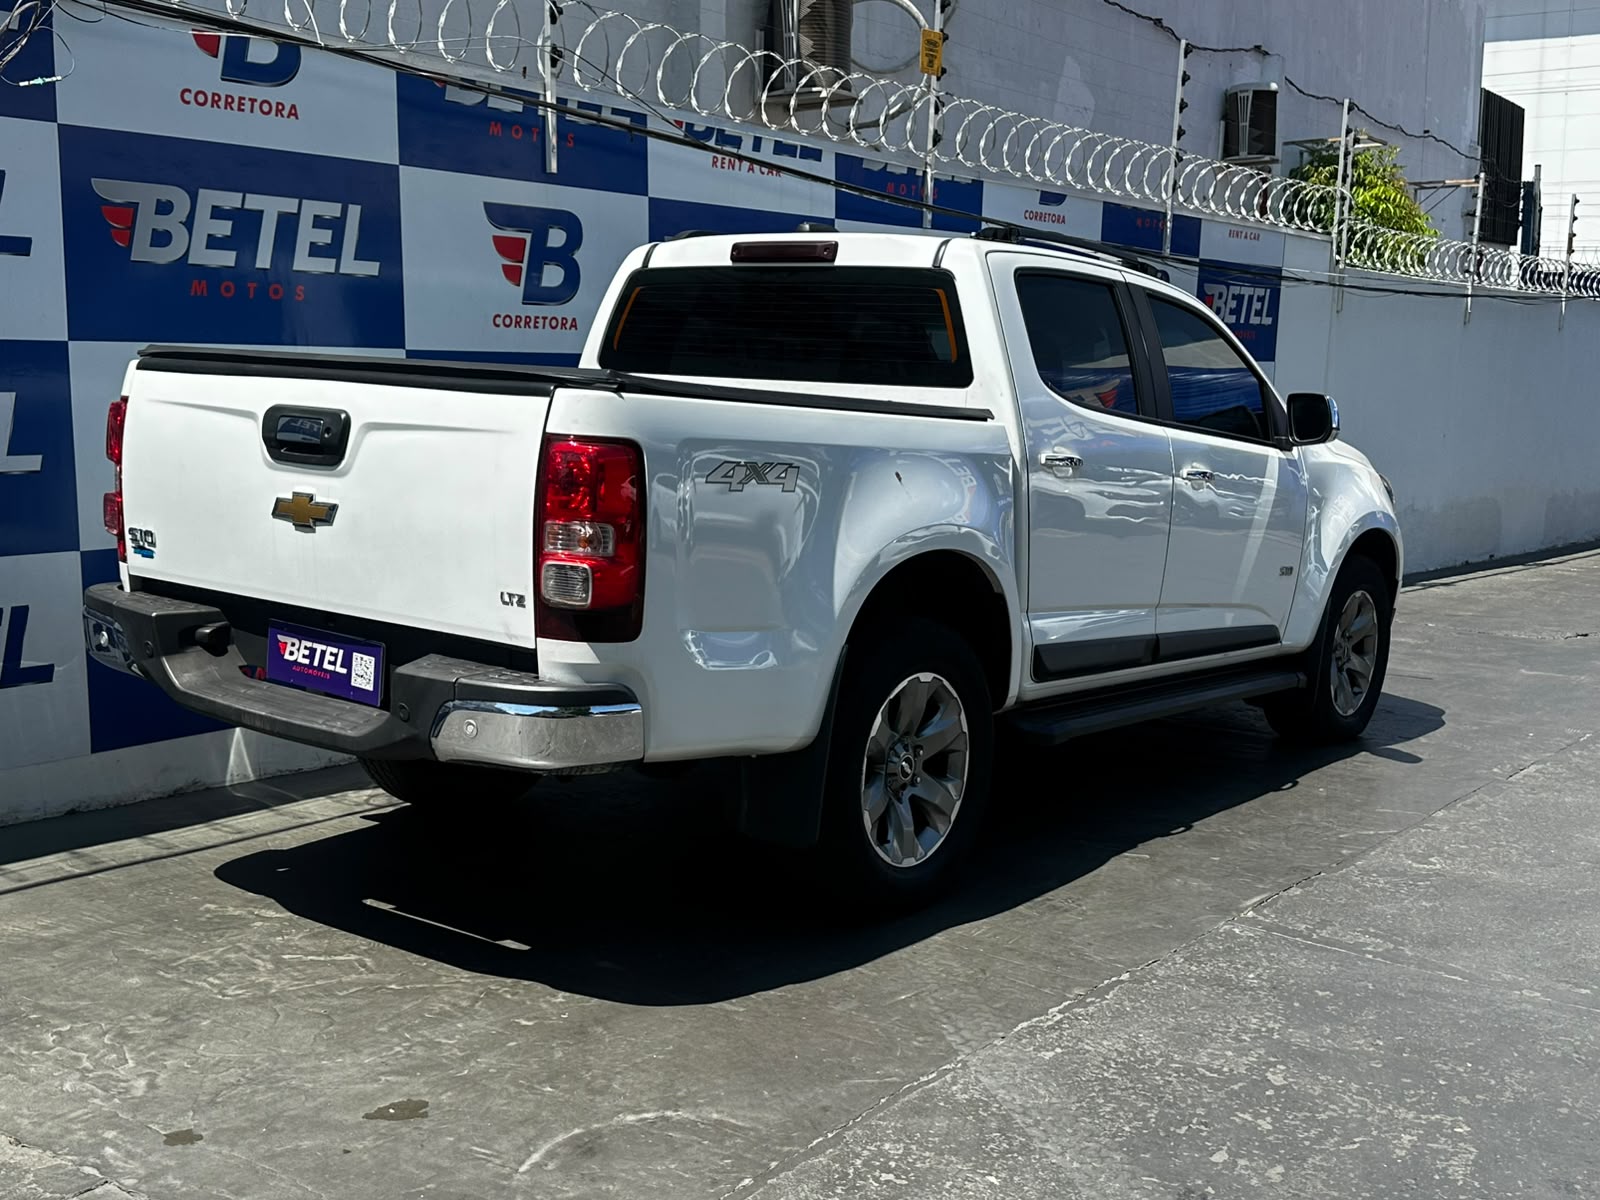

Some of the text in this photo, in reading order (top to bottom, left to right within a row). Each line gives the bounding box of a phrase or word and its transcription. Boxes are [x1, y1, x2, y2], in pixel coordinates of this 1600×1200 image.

[180, 87, 299, 121] CORRETORA
[488, 121, 575, 149] MOTS
[712, 155, 743, 172] RENT
[90, 177, 381, 277] BETEL
[1023, 209, 1067, 225] CORRETORA
[1228, 229, 1243, 240] RENT
[190, 279, 305, 300] MOTOS
[1204, 283, 1273, 326] BETEL
[492, 313, 579, 332] CORRETORA
[128, 527, 157, 548] S10
[500, 591, 526, 608] LTZ
[277, 634, 348, 675] BETEL
